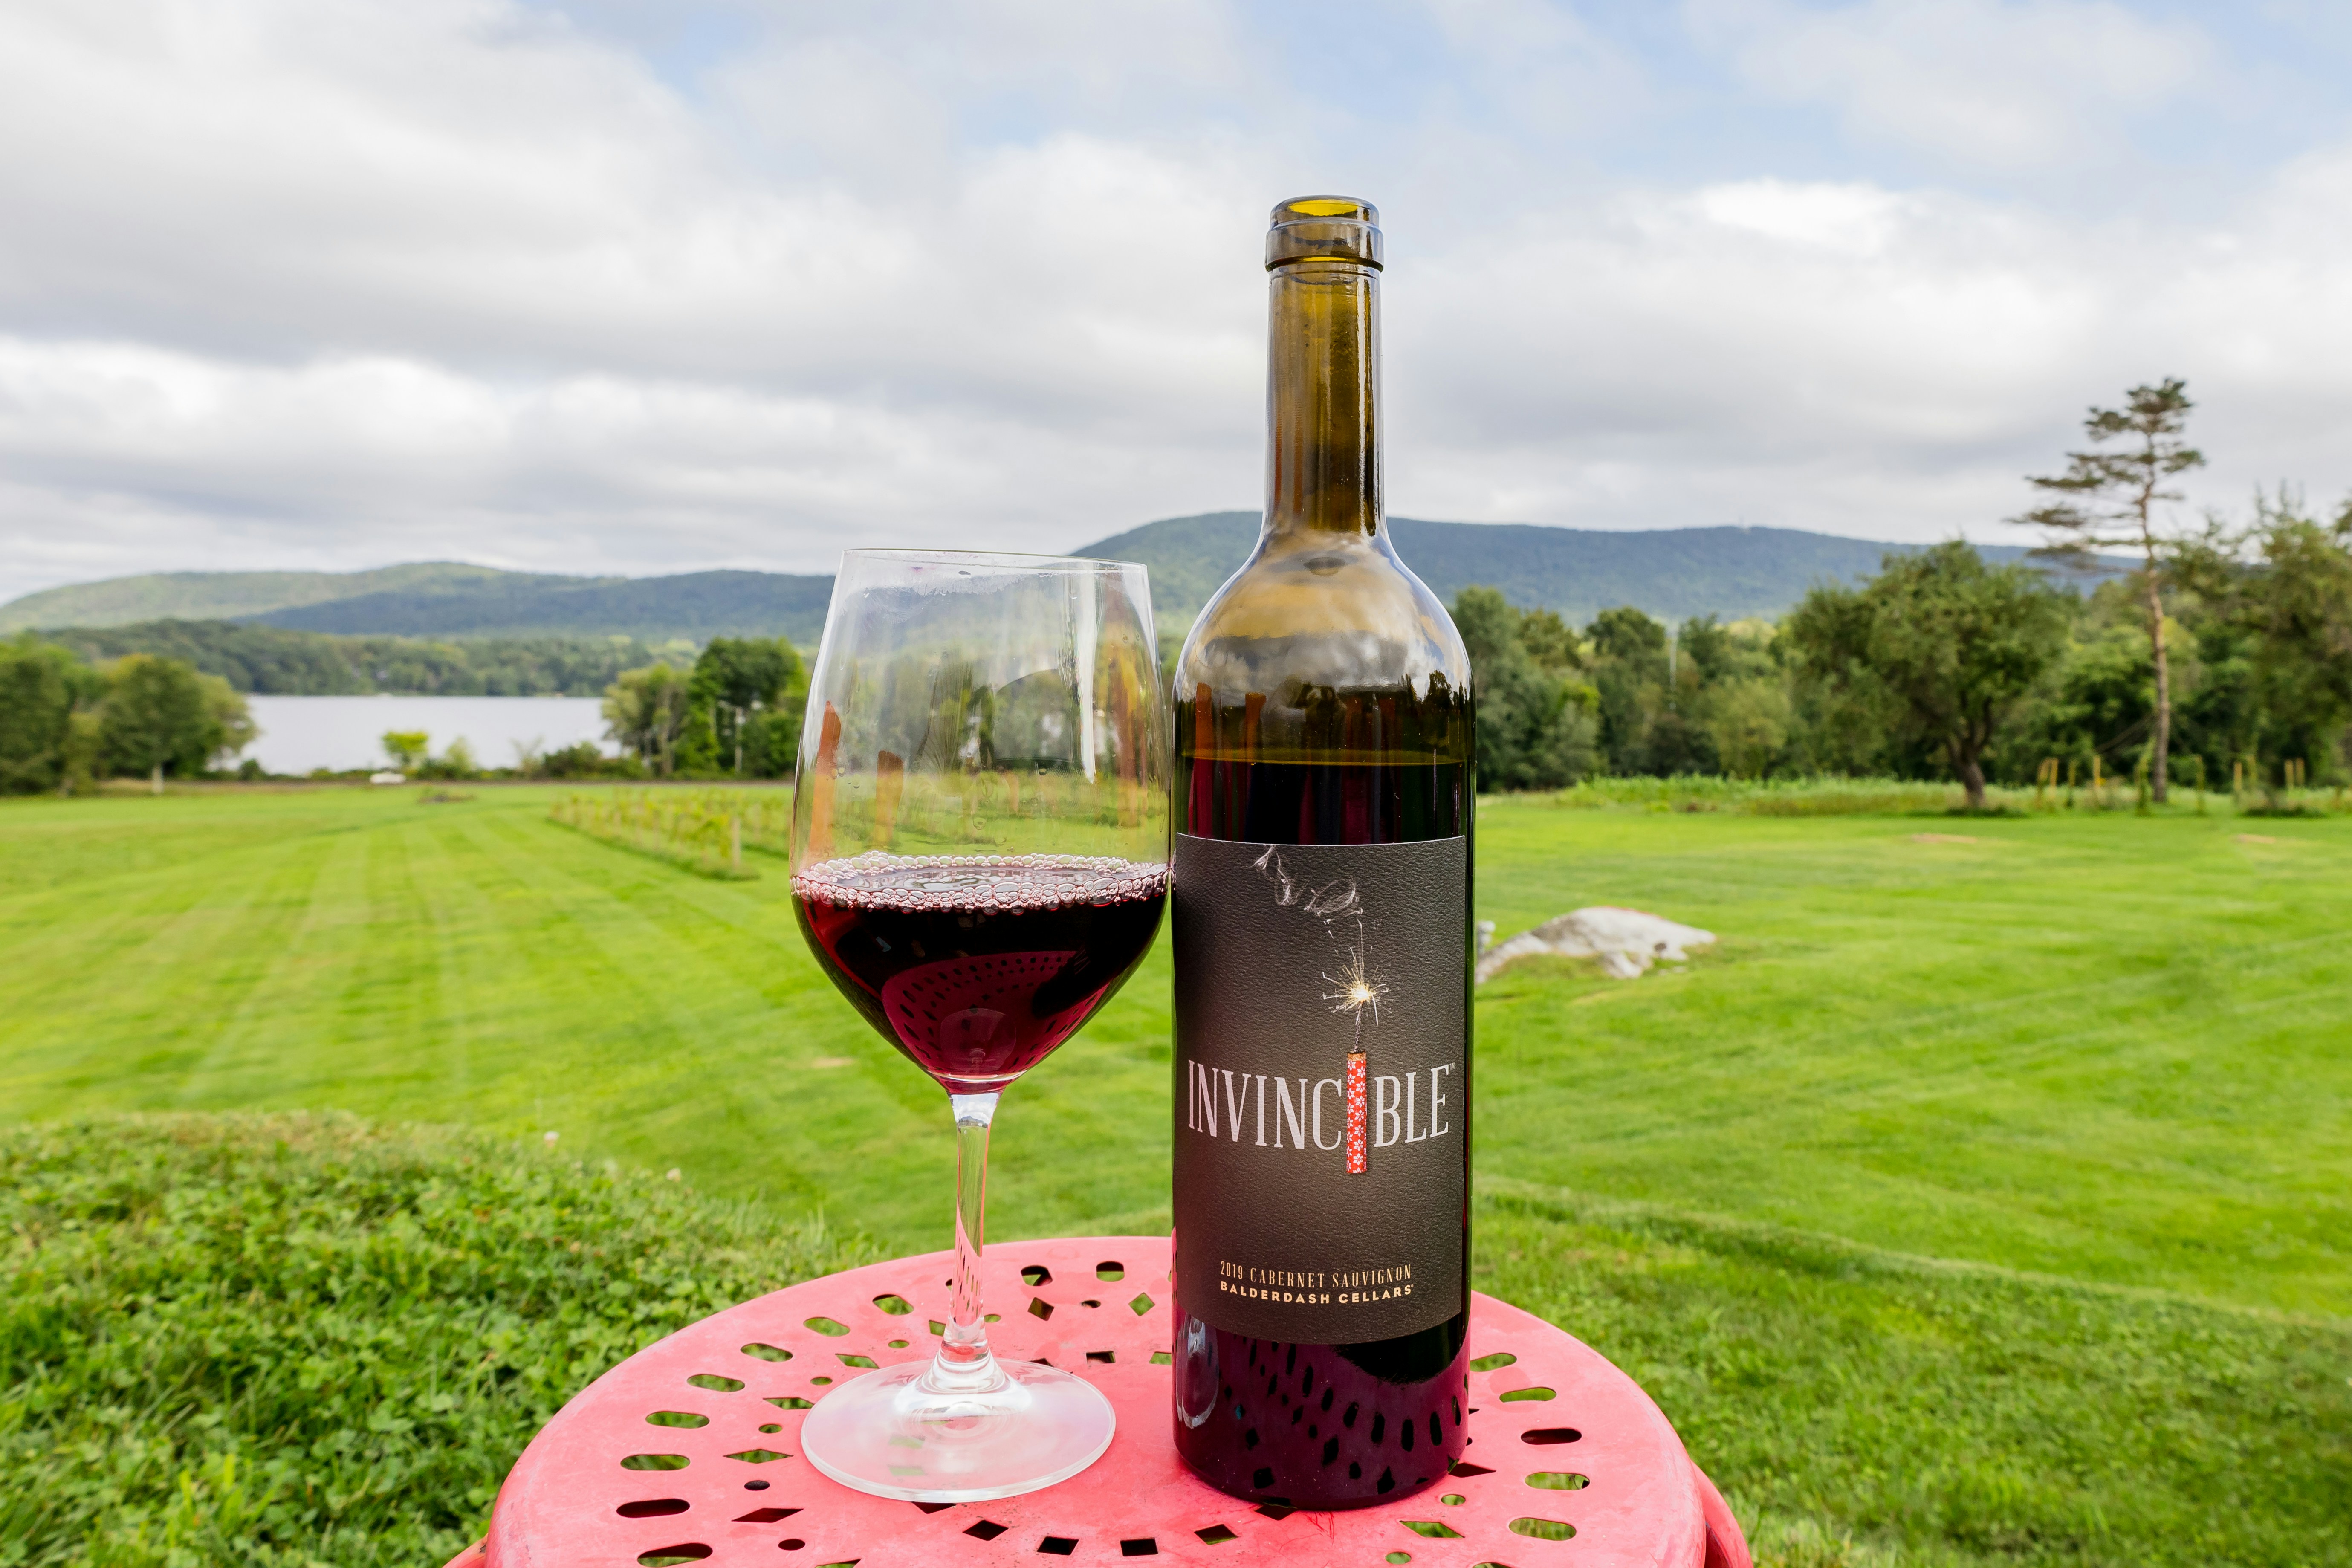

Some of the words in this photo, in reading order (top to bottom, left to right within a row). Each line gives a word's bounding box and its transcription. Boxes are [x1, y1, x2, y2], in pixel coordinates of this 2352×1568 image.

[1221, 1261, 1243, 1280] 2019
[1250, 1267, 1325, 1288] CABERNET
[1332, 1264, 1411, 1288] SAUVIGNON
[1221, 1280, 1330, 1304] BALDERDASH
